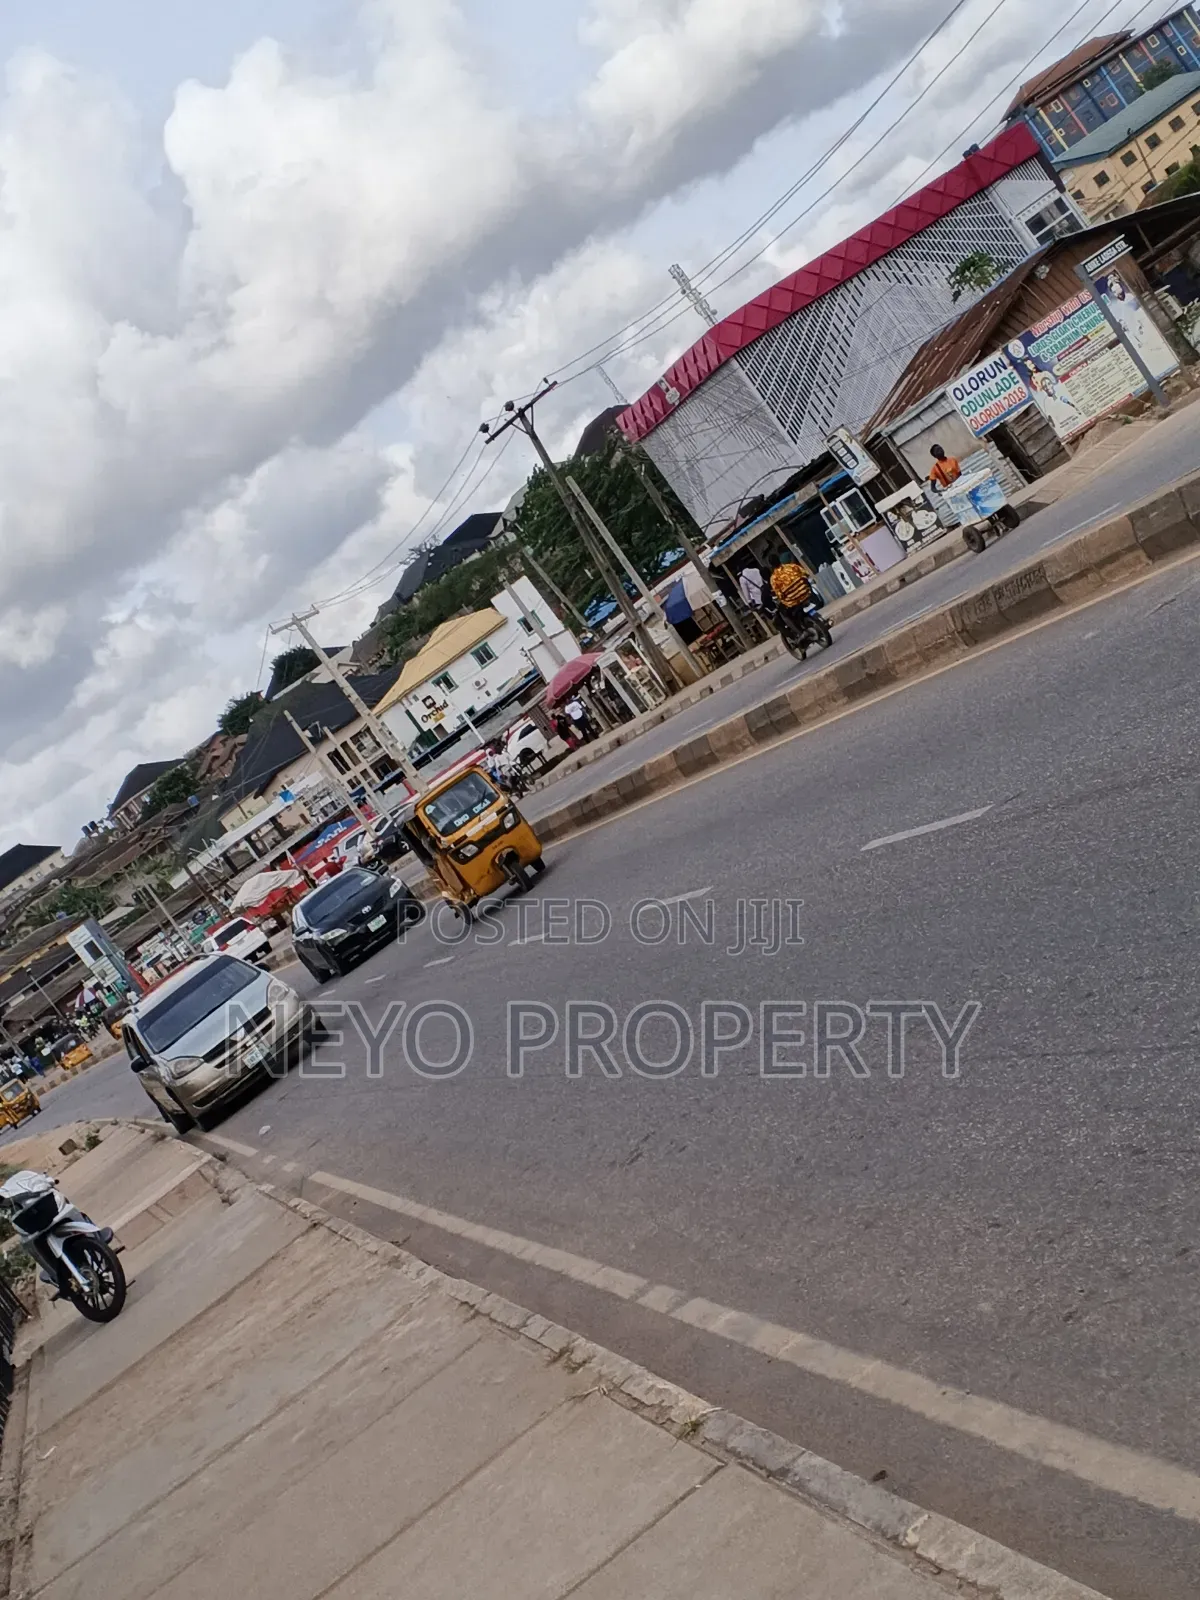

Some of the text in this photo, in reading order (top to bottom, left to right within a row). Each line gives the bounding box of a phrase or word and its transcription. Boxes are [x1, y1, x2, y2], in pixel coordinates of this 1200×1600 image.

[1031, 309, 1064, 337] Worship
[1061, 297, 1082, 316] with
[1040, 351, 1050, 362] &
[1047, 328, 1080, 359] SERAPHIM
[1079, 311, 1105, 335] CHURC
[1050, 319, 1075, 341] GLORY
[1071, 294, 1110, 328] CHERUM
[953, 357, 1008, 401] OLORUN
[960, 372, 1019, 417] ODUNLADE
[970, 387, 1027, 430] OLORUN 2018
[421, 699, 449, 723] Orchid
